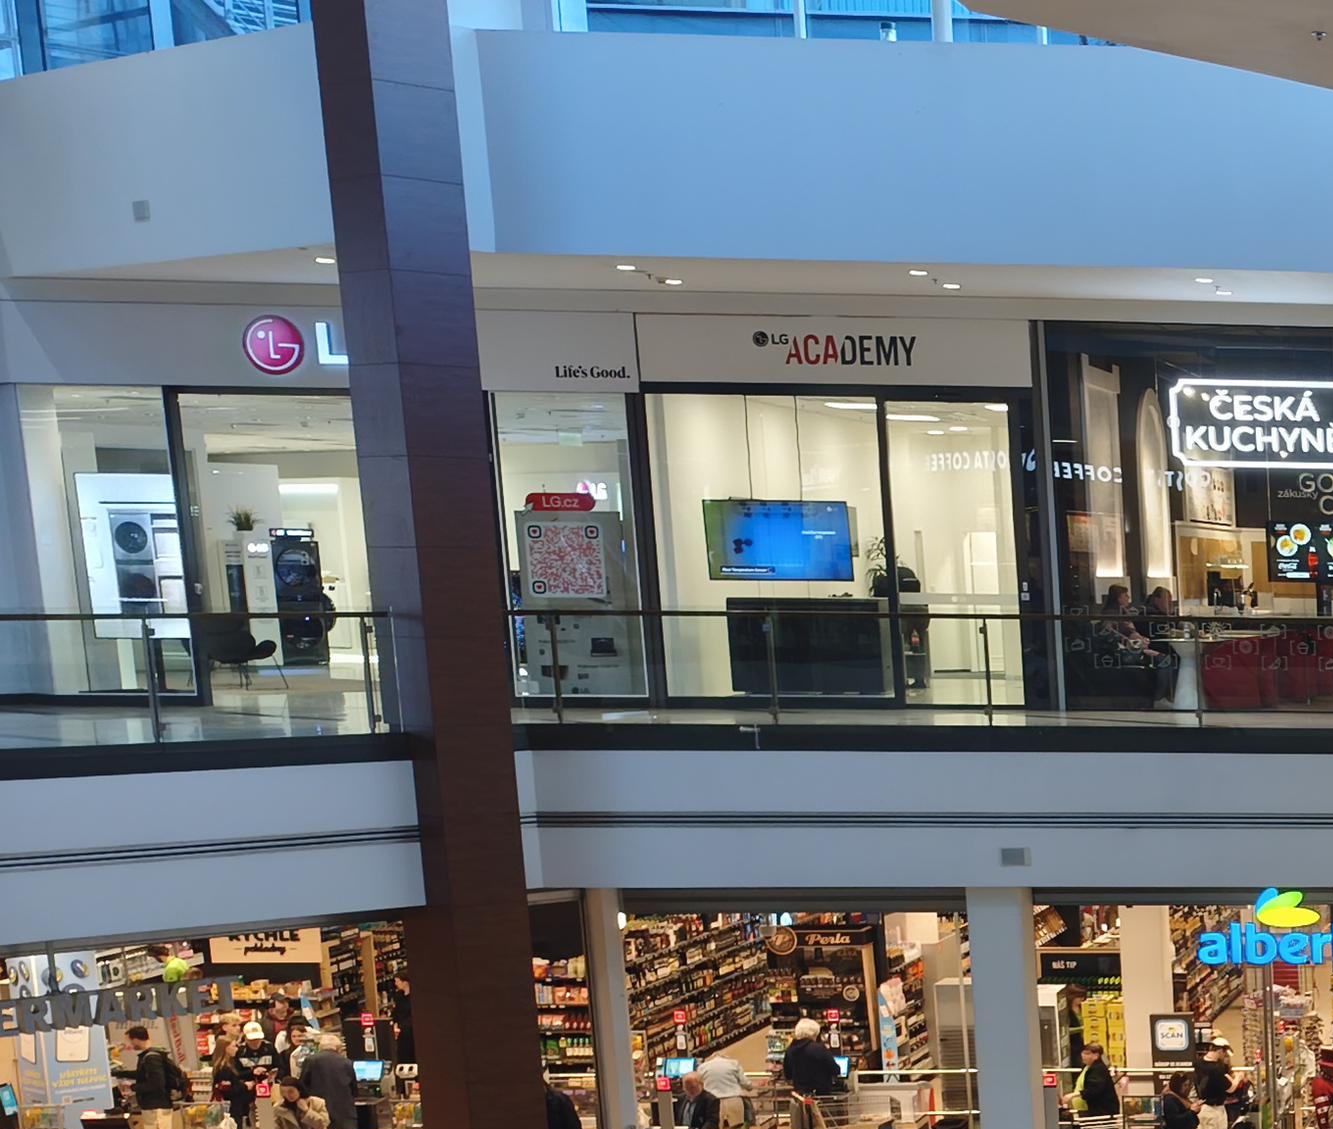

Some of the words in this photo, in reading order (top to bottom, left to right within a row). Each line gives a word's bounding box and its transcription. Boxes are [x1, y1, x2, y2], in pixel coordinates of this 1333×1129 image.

[315, 322, 349, 365] L
[771, 333, 789, 345] LG
[785, 334, 917, 367] ACADEMY
[555, 365, 588, 379] Life's
[590, 366, 631, 379] Good.
[1208, 389, 1320, 422] ČESKÁ
[542, 496, 579, 508] LG.cz
[804, 933, 851, 945] Perla
[1160, 1031, 1183, 1040] SCAN
